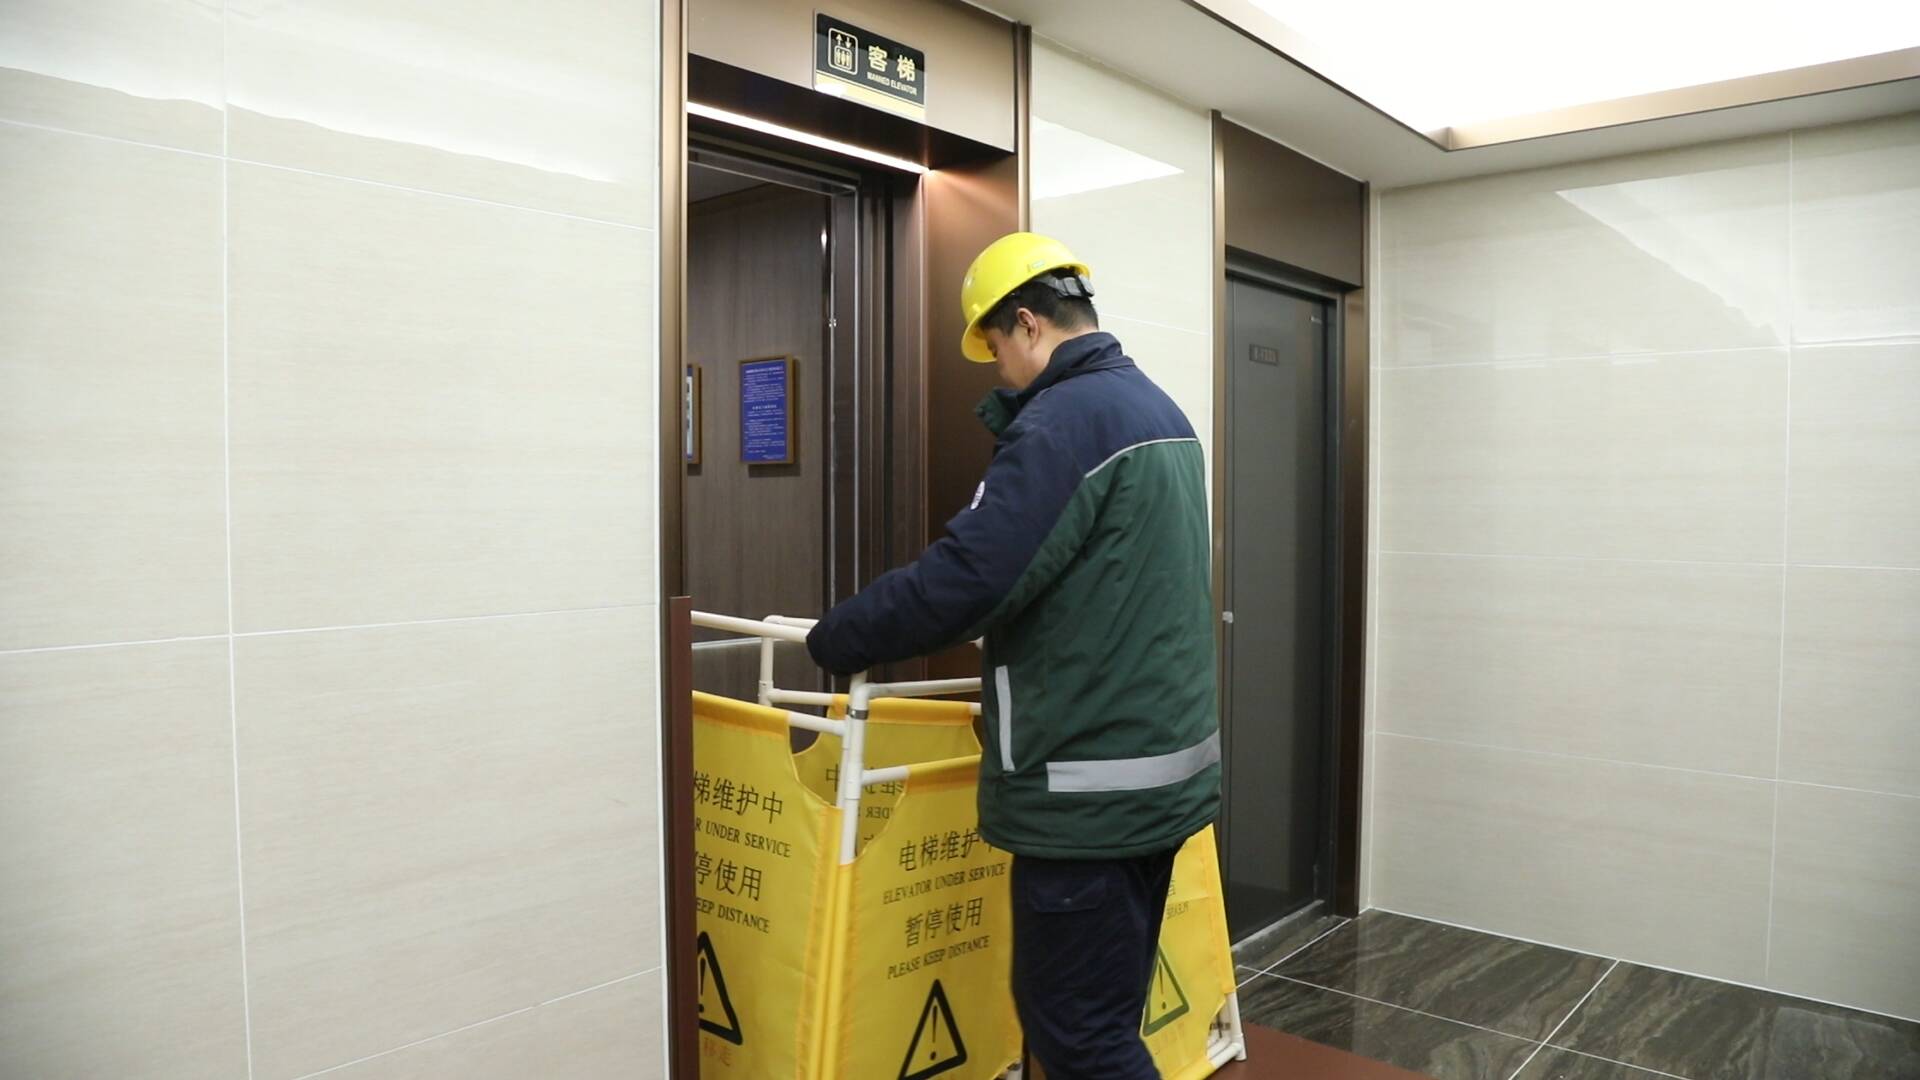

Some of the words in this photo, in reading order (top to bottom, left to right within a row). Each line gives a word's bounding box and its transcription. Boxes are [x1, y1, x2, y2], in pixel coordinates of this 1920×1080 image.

[868, 45, 917, 82] 客梯
[891, 79, 918, 96] ELEVATOR
[705, 820, 740, 843] UNDER
[745, 832, 792, 859] SERVICE
[899, 828, 992, 871] 电梯维护
[883, 879, 932, 905] ELEVATOR
[935, 871, 965, 890] UNDER
[968, 862, 1006, 882] SERVICE
[718, 904, 770, 934] DISTANCE
[905, 897, 983, 948] 暂停使用
[887, 956, 921, 980] PLEASE
[923, 948, 946, 966] KEEP
[948, 935, 990, 959] DISTANCE
